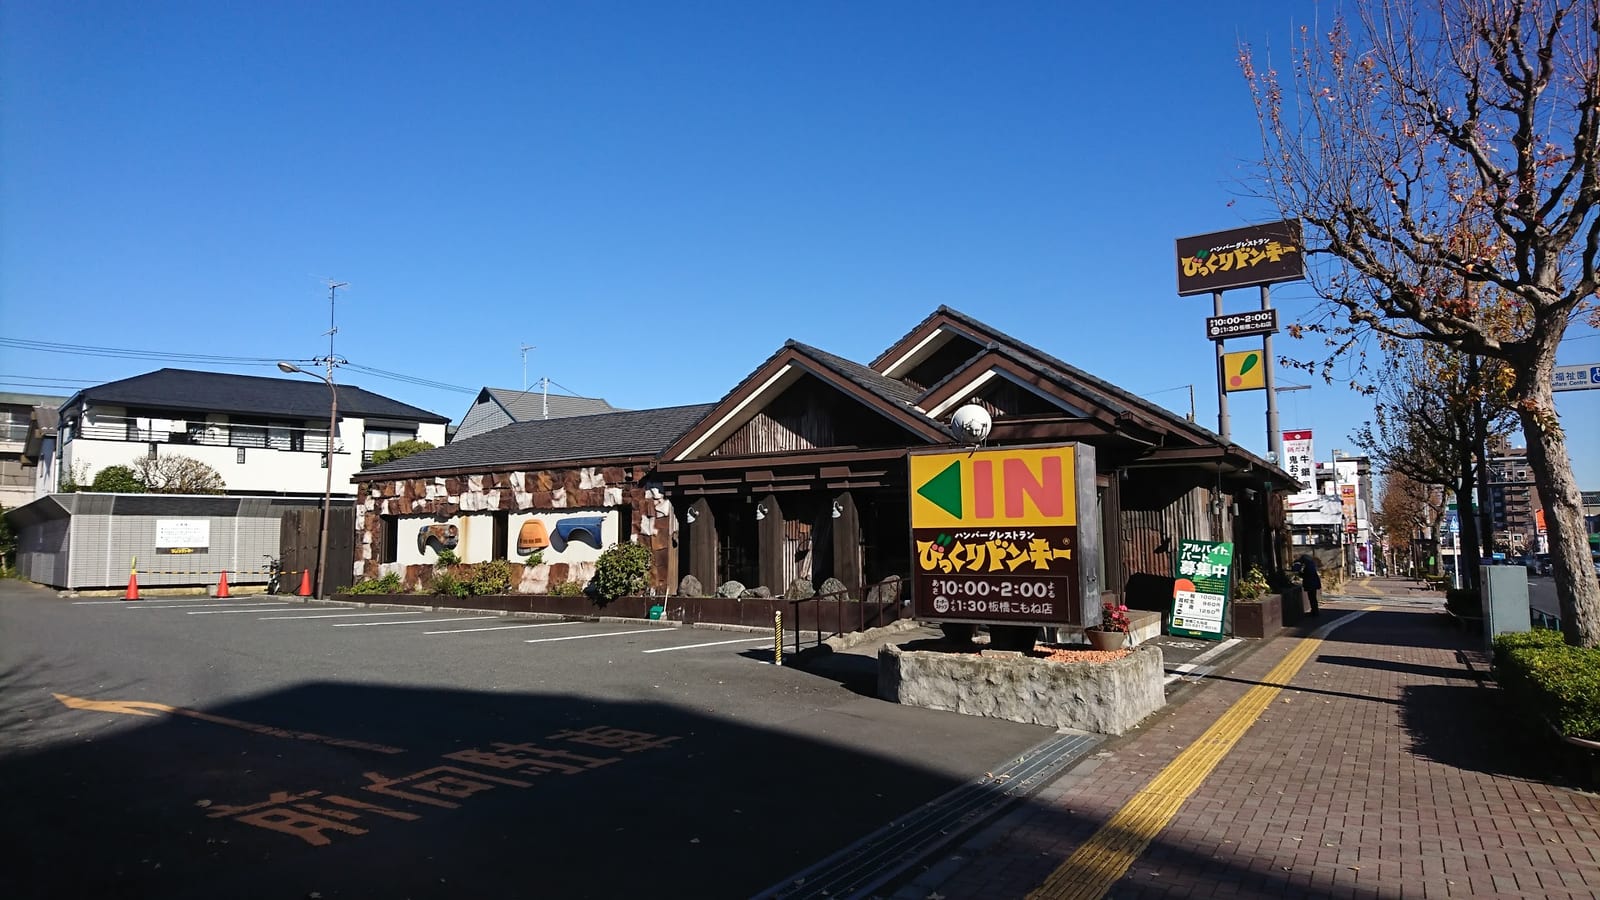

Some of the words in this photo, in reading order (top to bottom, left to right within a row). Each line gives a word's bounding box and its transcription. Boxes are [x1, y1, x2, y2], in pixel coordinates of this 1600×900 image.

[1209, 238, 1270, 253] ハンバーグレストラン
[1181, 241, 1297, 278] びっくりドンキー
[973, 456, 1064, 519] IN
[954, 530, 1035, 541] ハンバーグレストラン
[917, 538, 1072, 574] びっくりドンキー
[1179, 560, 1228, 578] 募集中
[957, 600, 987, 612] 1:30
[988, 601, 1053, 615] 板橋こもね店
